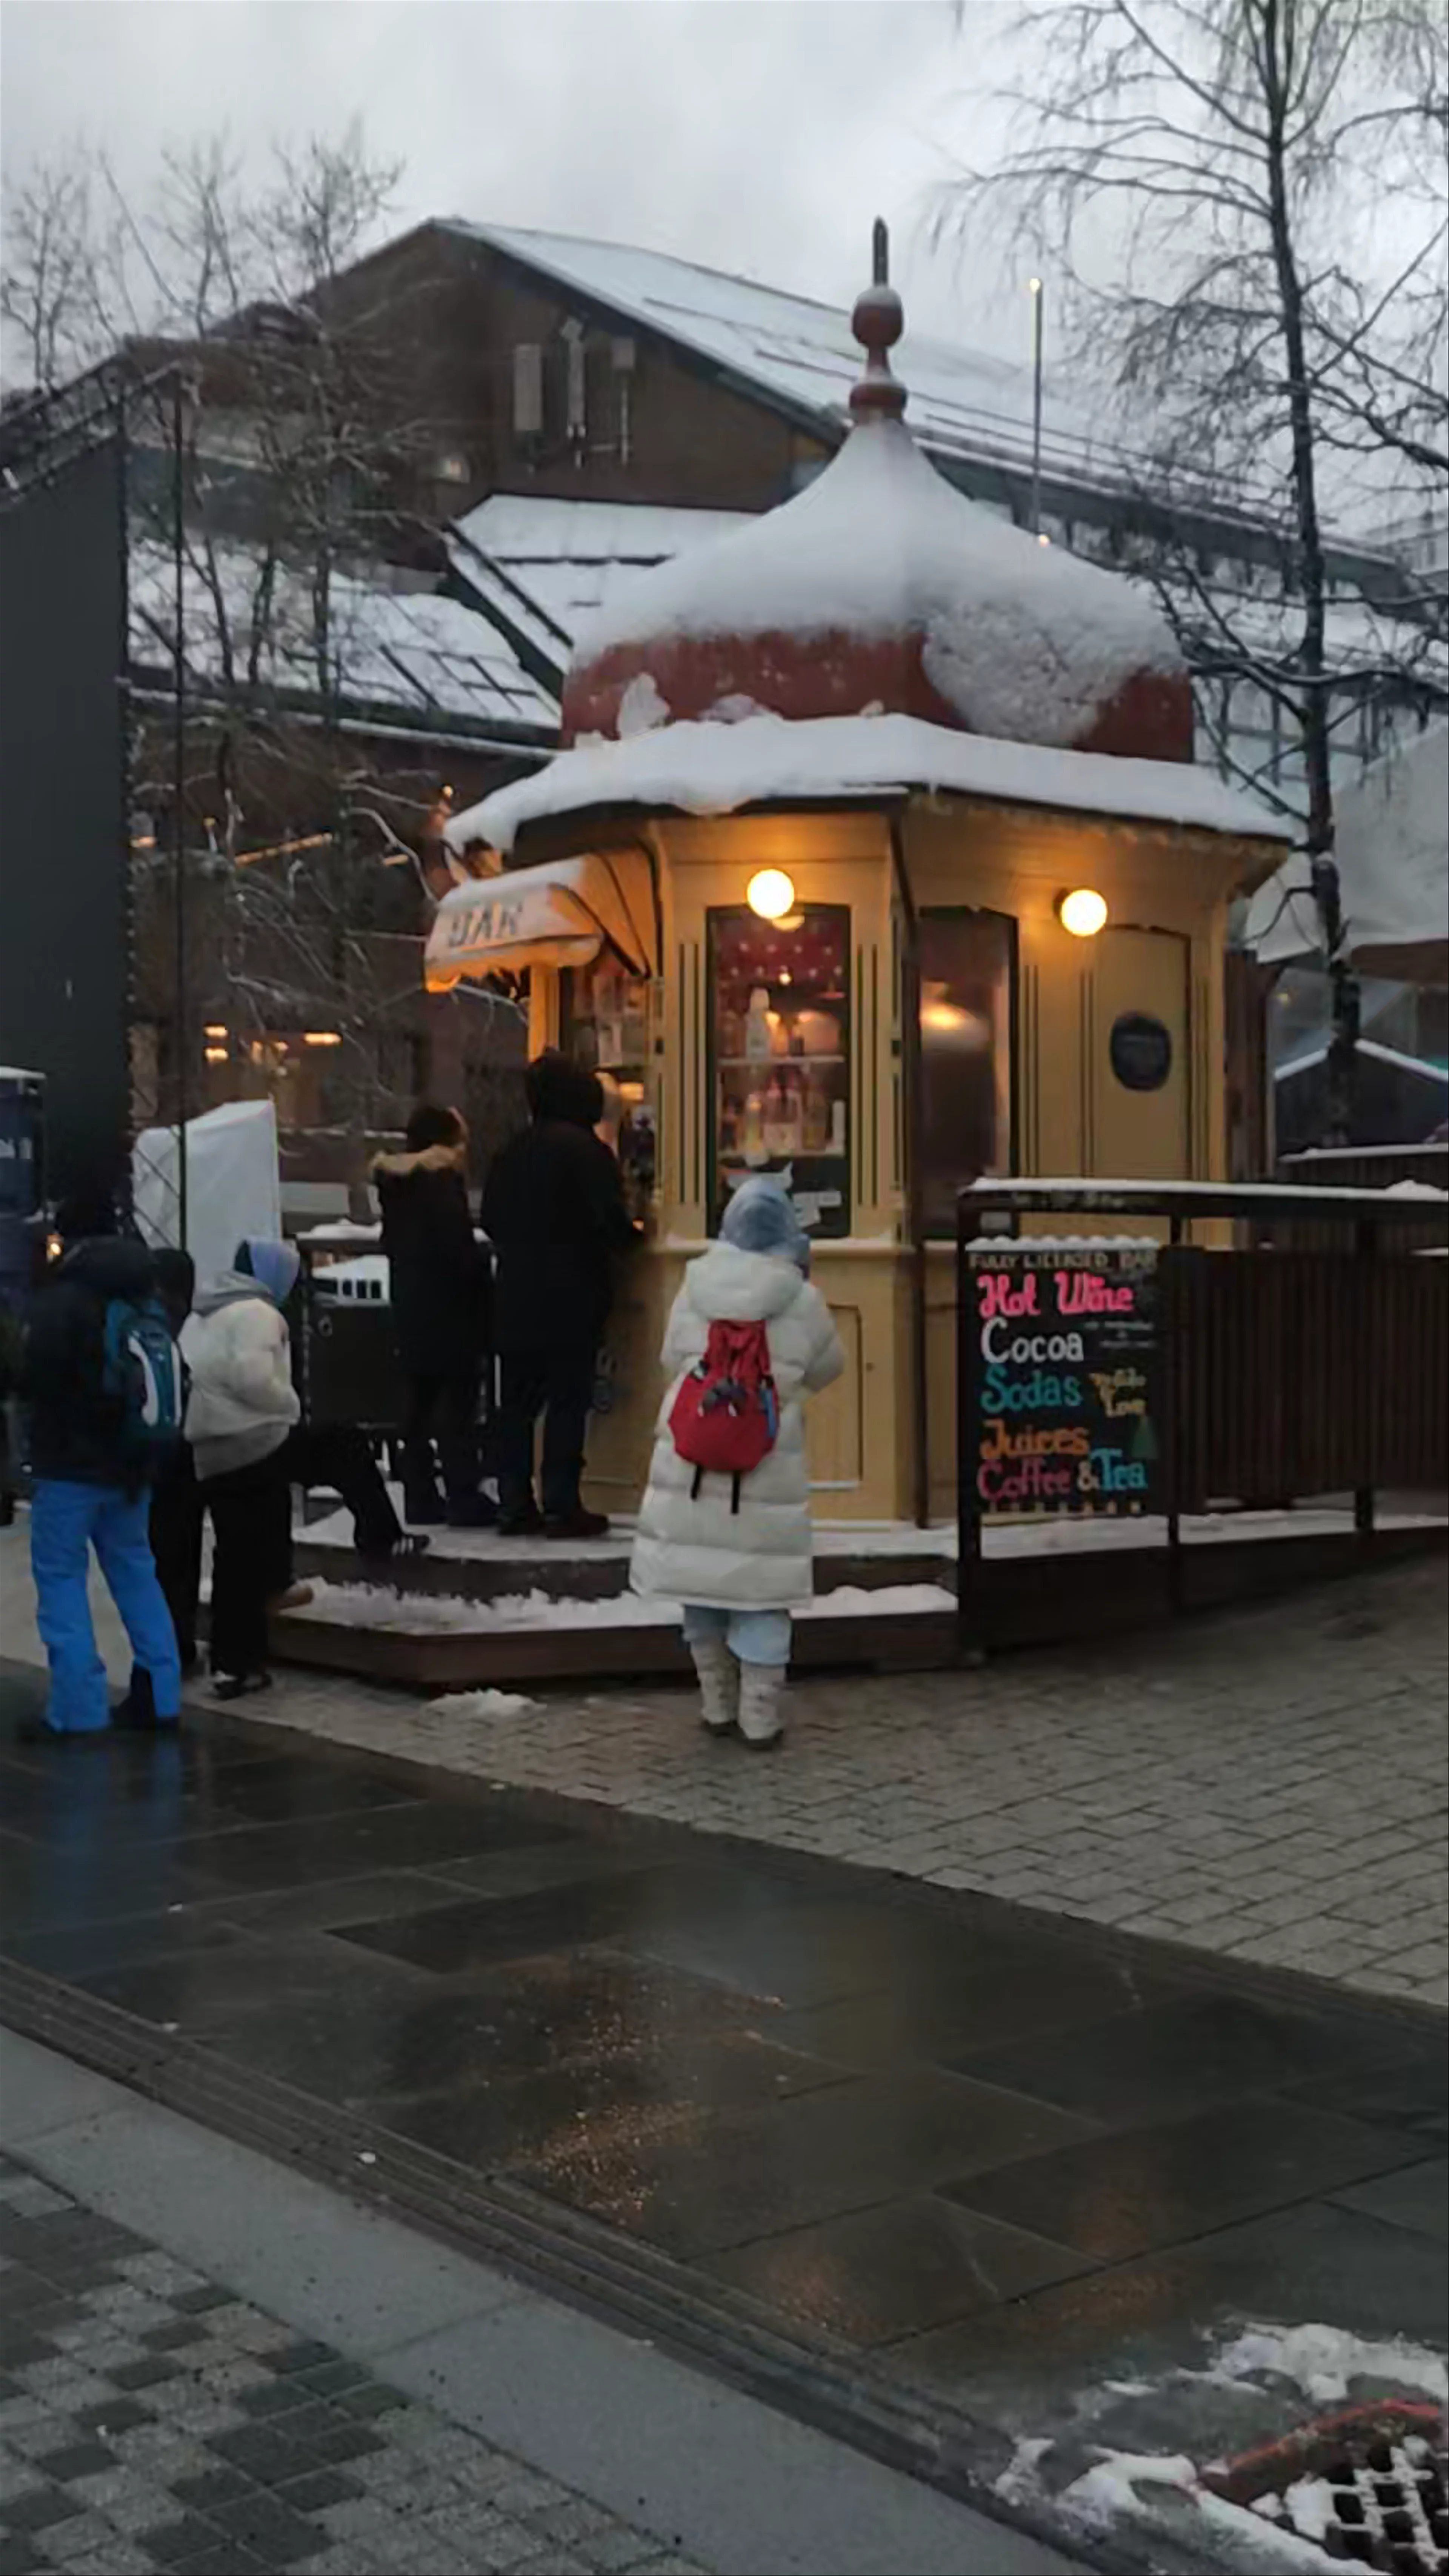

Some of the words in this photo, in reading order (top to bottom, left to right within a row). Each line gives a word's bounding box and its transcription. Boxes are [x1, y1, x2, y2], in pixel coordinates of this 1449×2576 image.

[977, 1273, 1041, 1319] Hot
[1054, 1270, 1134, 1315] Wine
[981, 1316, 1084, 1364] Cocoa
[981, 1363, 1083, 1414] Sodas
[980, 1418, 1090, 1460] Juices
[977, 1457, 1072, 1501] Coffee
[1090, 1447, 1148, 1491] Tea
